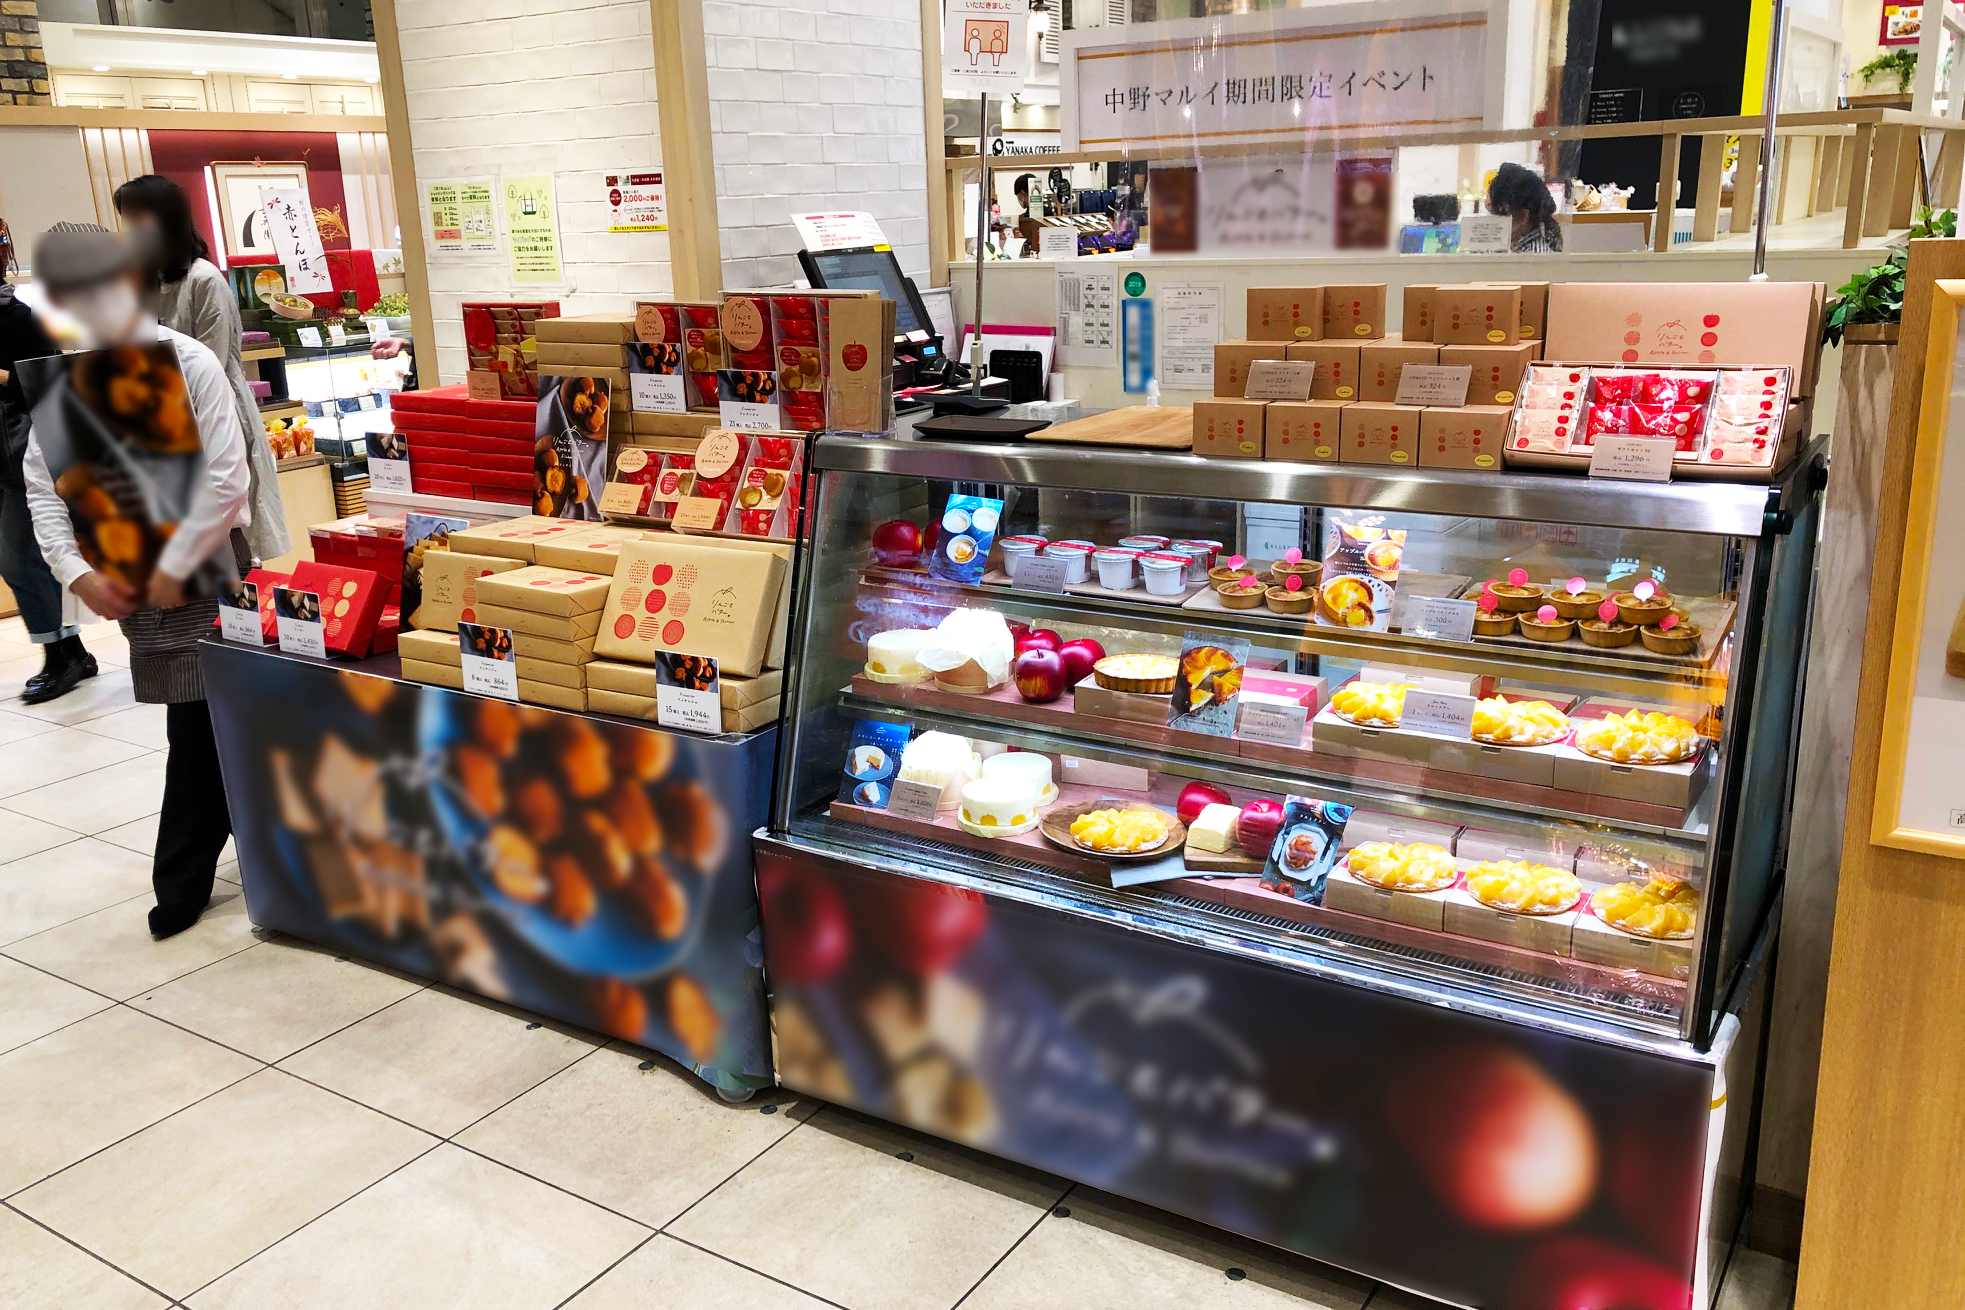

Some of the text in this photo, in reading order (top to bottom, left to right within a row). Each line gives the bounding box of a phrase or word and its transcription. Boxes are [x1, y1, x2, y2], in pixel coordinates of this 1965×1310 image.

[966, 2, 1011, 10] いただきました
[1105, 65, 1435, 114] 中野マルイ期間限定イベント
[1006, 146, 1033, 155] YANAKA
[283, 204, 310, 272] 赤とんぼ
[732, 314, 752, 322] りんごと
[1658, 333, 1684, 342] りんごと
[712, 600, 734, 608] りんごと
